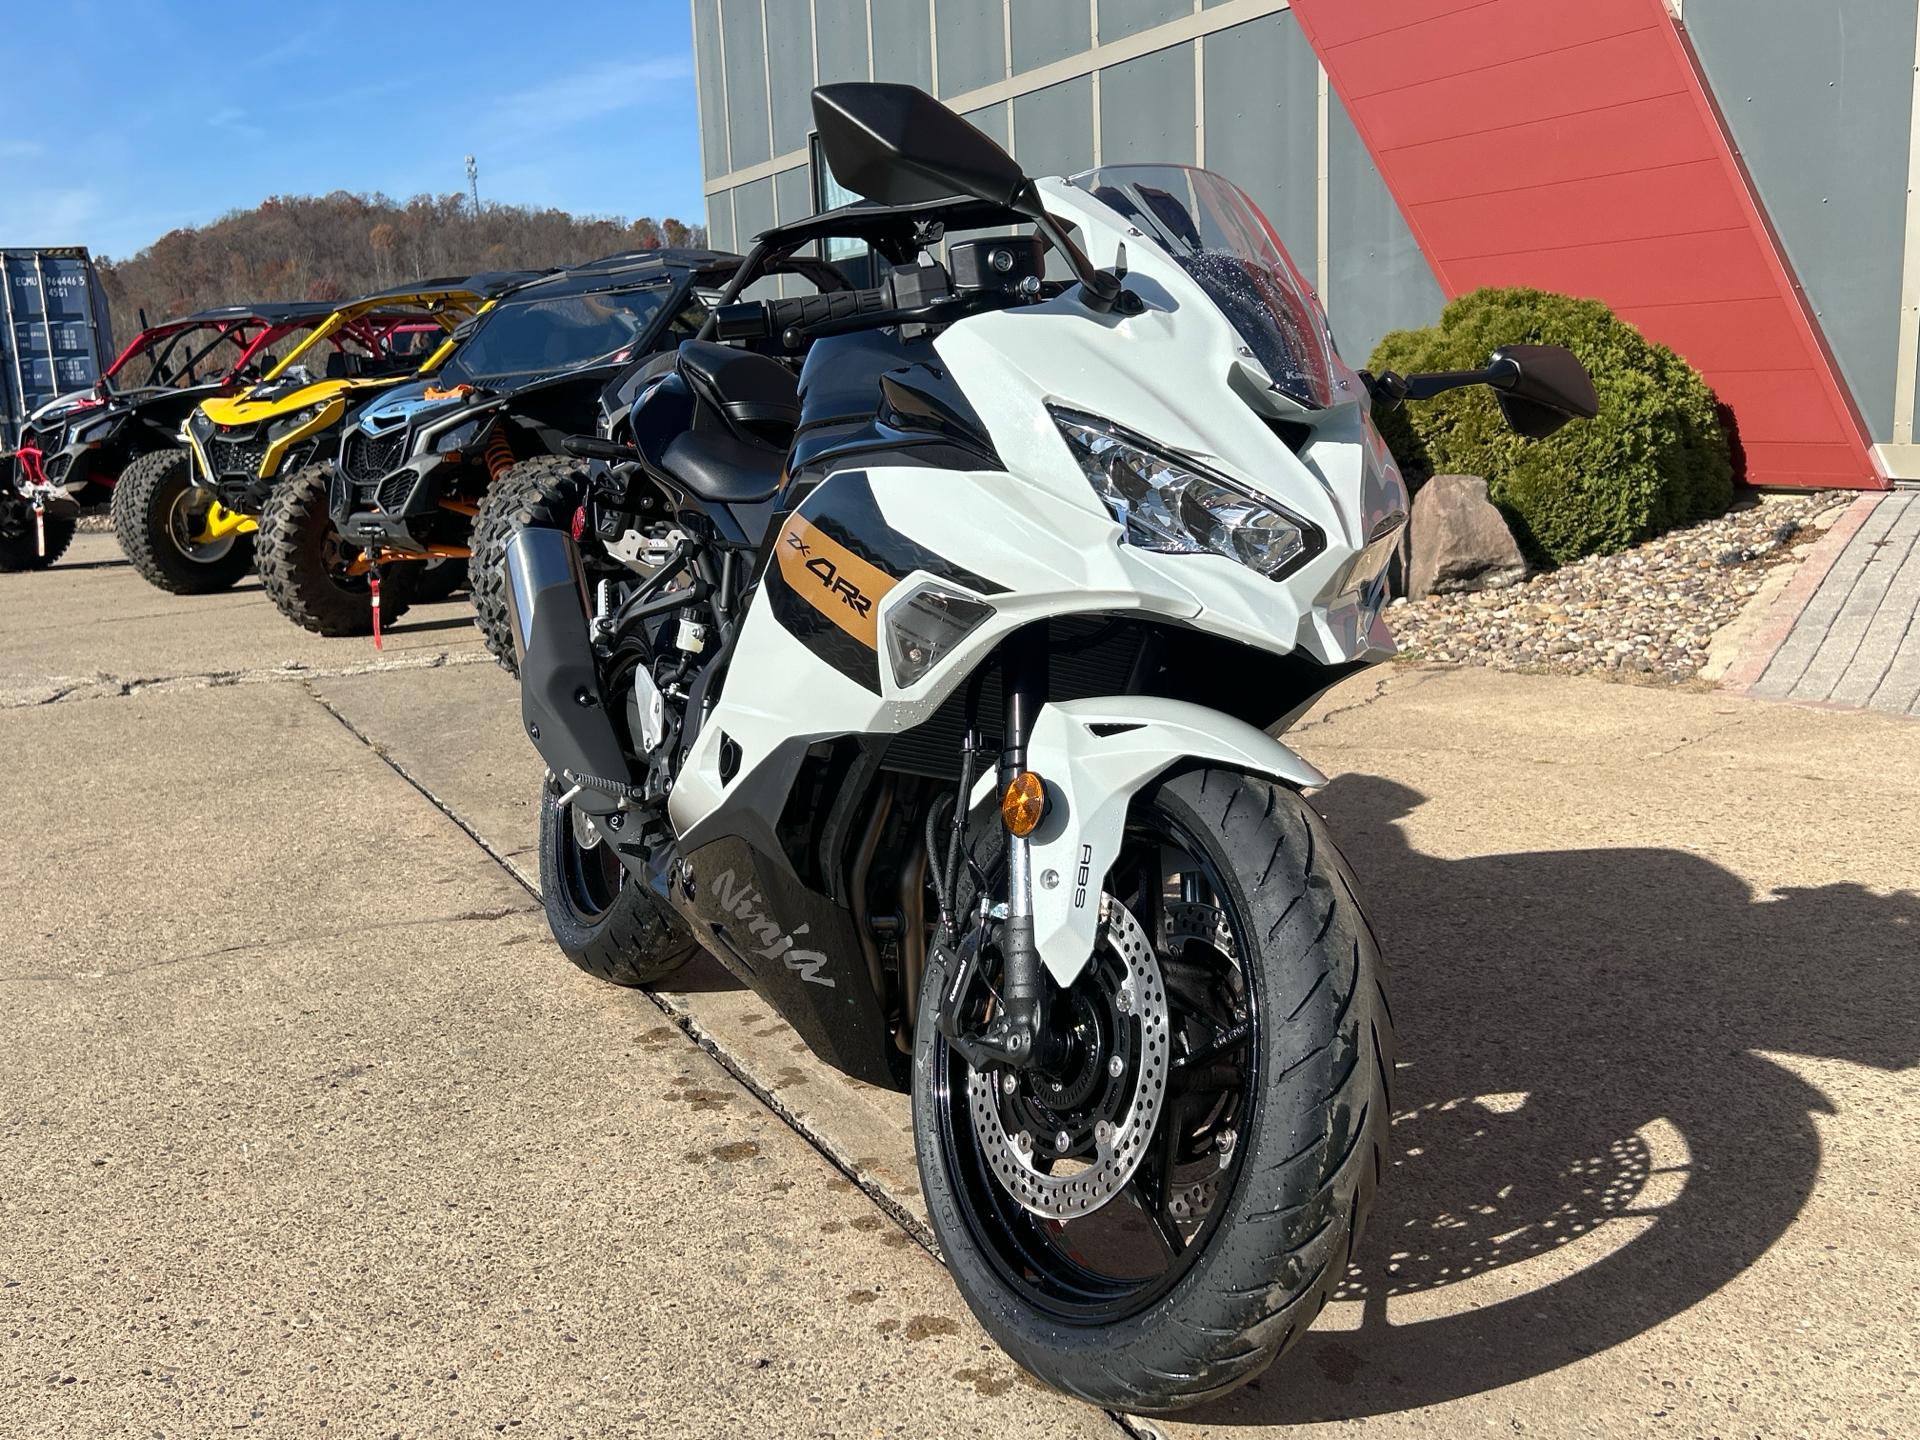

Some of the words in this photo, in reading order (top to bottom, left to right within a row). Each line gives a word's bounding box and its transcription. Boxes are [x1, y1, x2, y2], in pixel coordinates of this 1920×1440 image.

[15, 276, 38, 287] ECMU
[46, 276, 77, 287] 964446
[79, 276, 85, 287] 5
[48, 287, 69, 298] 45G1
[1074, 843, 1092, 909] ABS
[711, 867, 837, 989] Ninja
